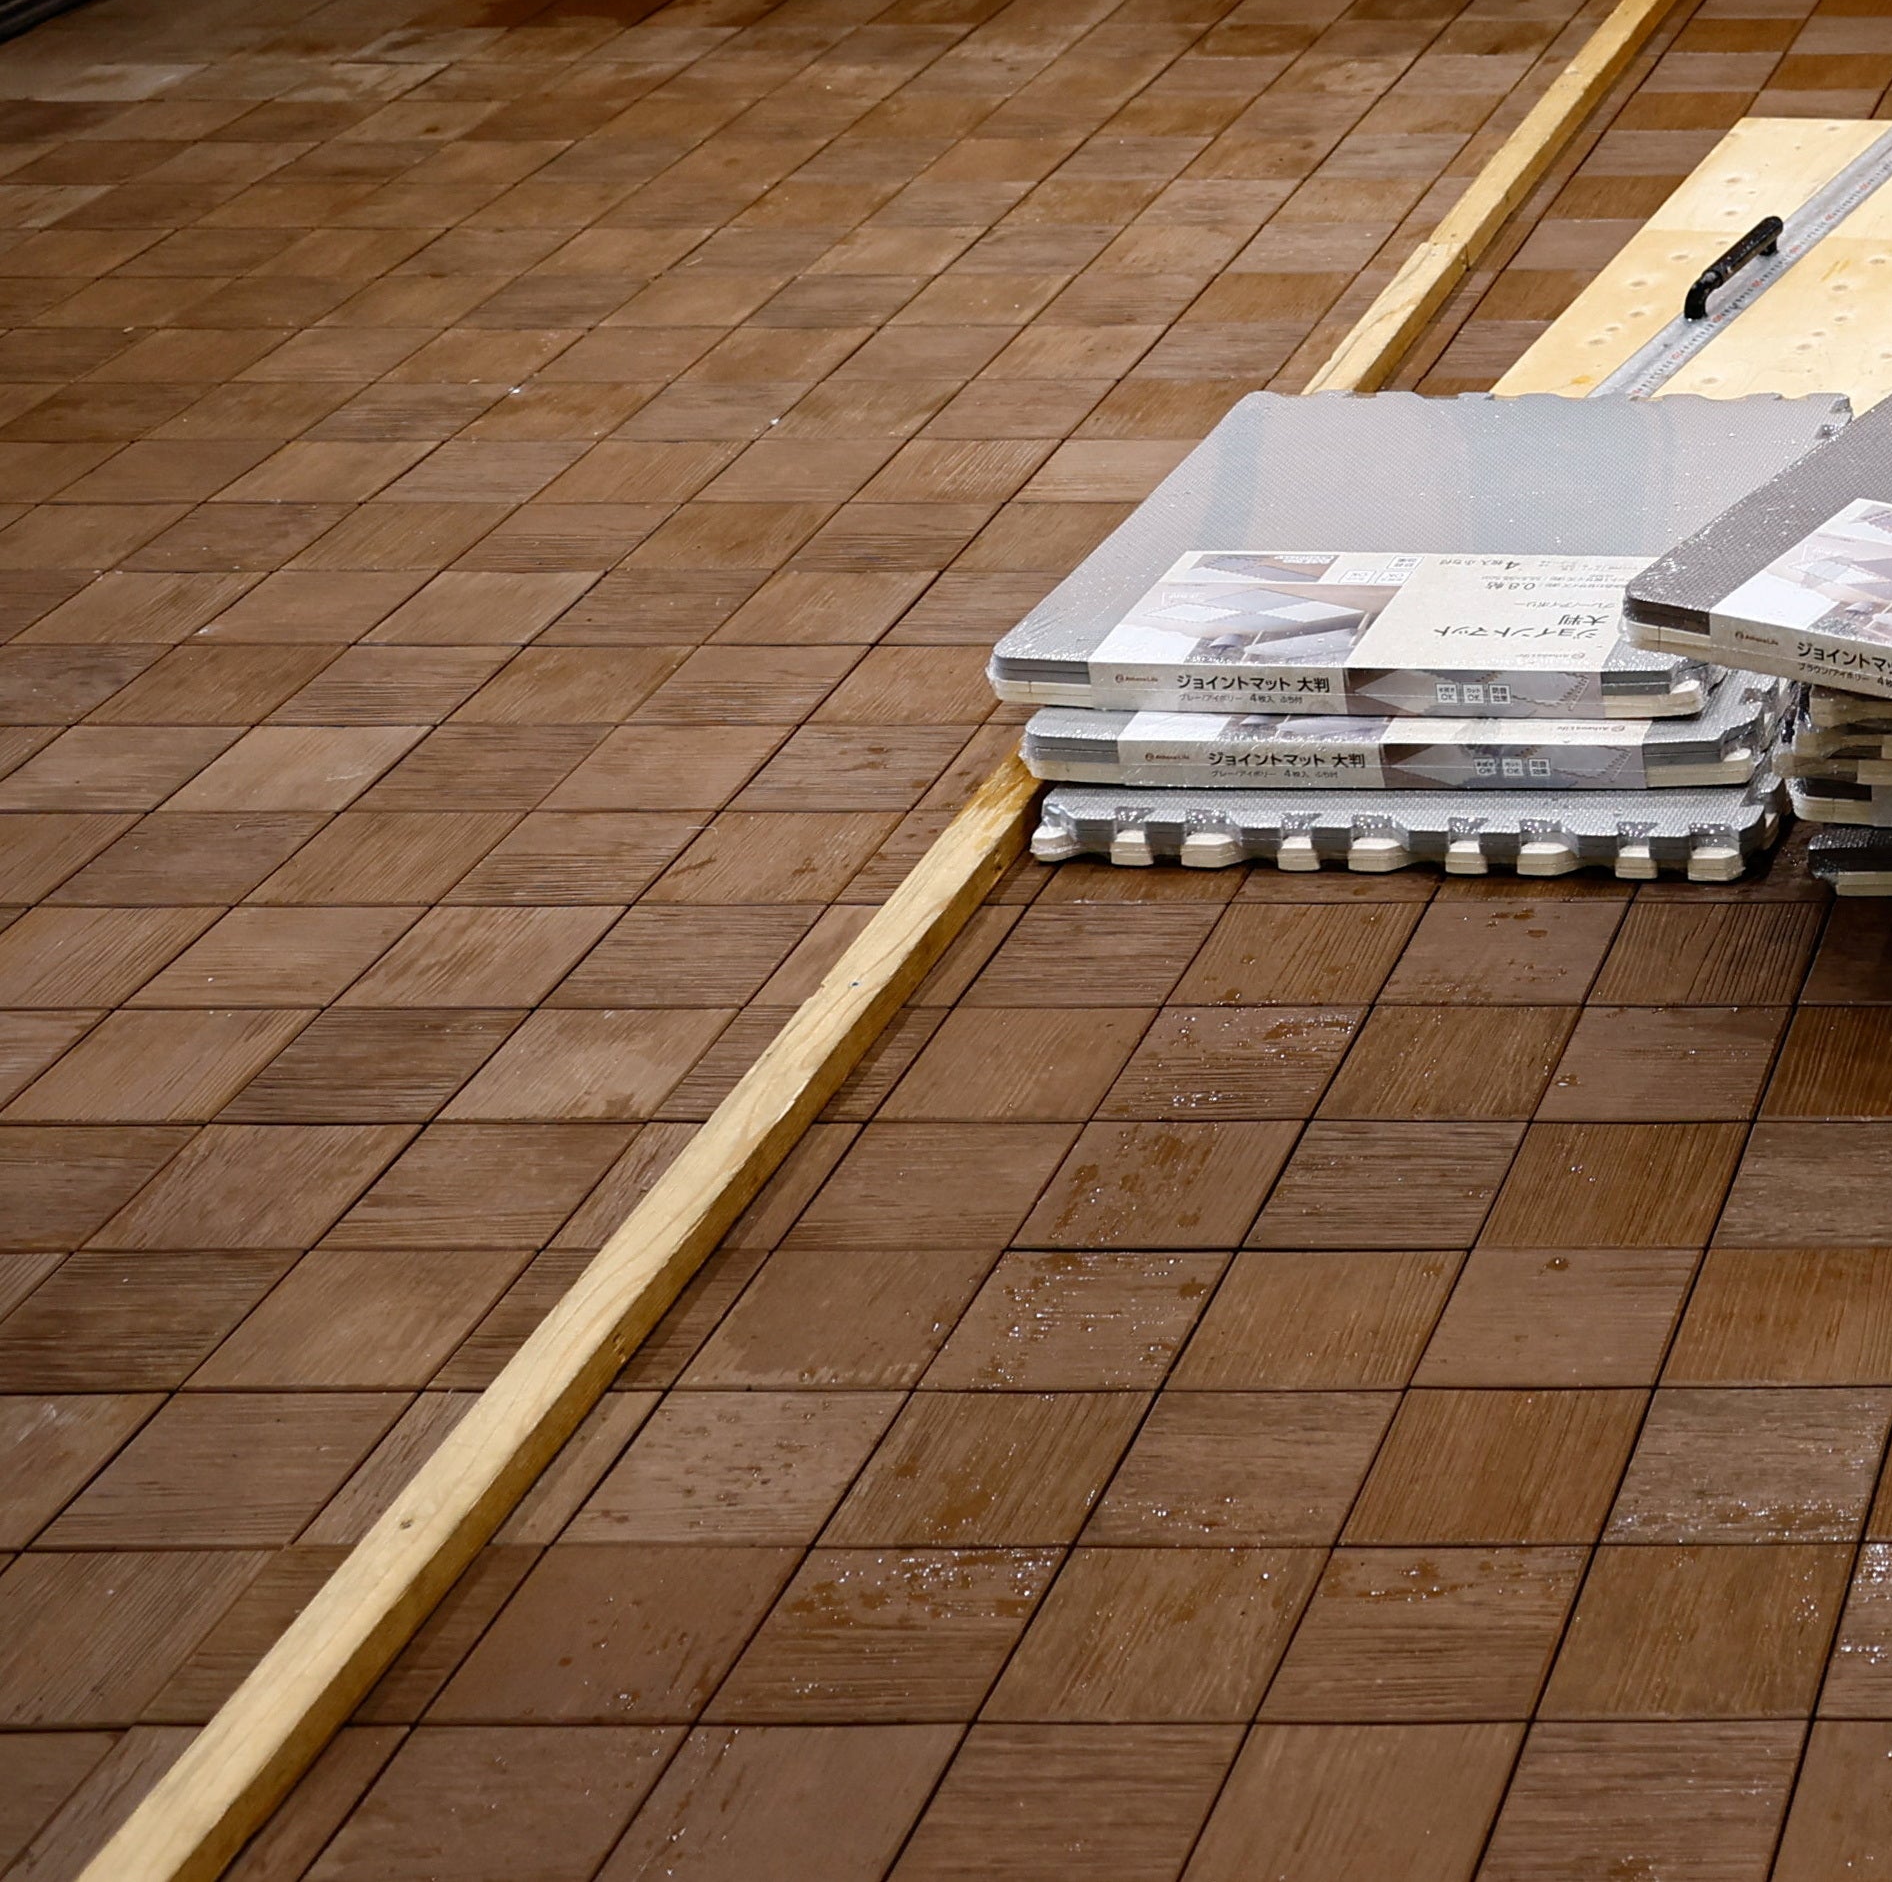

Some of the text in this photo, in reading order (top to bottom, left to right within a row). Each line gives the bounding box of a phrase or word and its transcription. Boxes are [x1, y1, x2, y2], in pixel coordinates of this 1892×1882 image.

[1558, 614, 1610, 626] 大判
[1433, 626, 1599, 640] ジョイントマット
[1177, 674, 1330, 694] ジョイントマット 大判
[1208, 752, 1365, 769] ジョイントマット 大判
